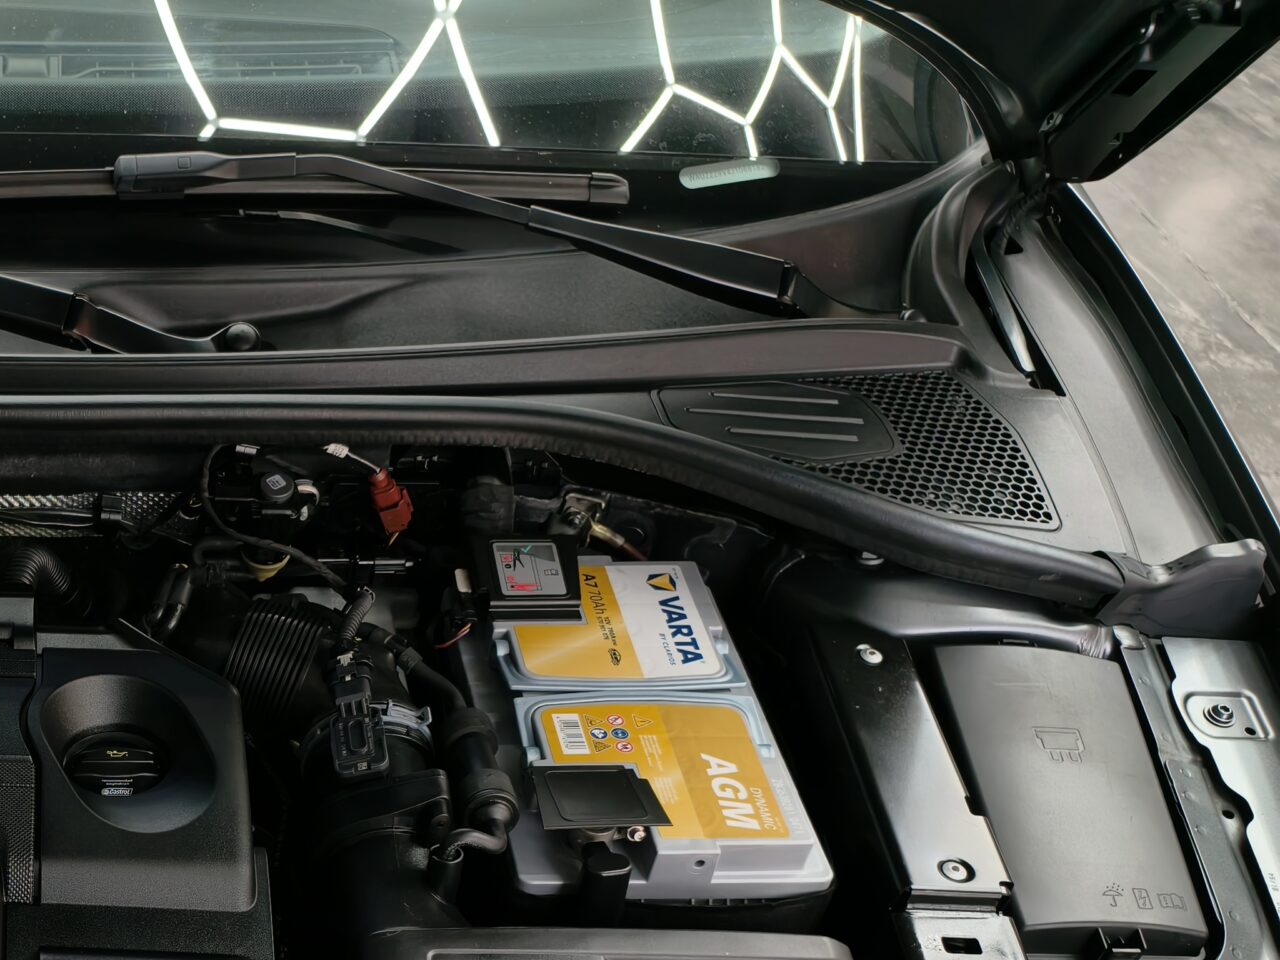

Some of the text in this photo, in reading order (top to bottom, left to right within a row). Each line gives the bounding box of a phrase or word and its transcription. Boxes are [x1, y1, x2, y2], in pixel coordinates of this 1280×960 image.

[582, 573, 607, 615] A7 70Ah
[658, 595, 704, 665] VARTA
[659, 633, 676, 666] BY CLARIOS
[700, 752, 761, 831] AGM
[749, 787, 777, 831] DYNAMIC
